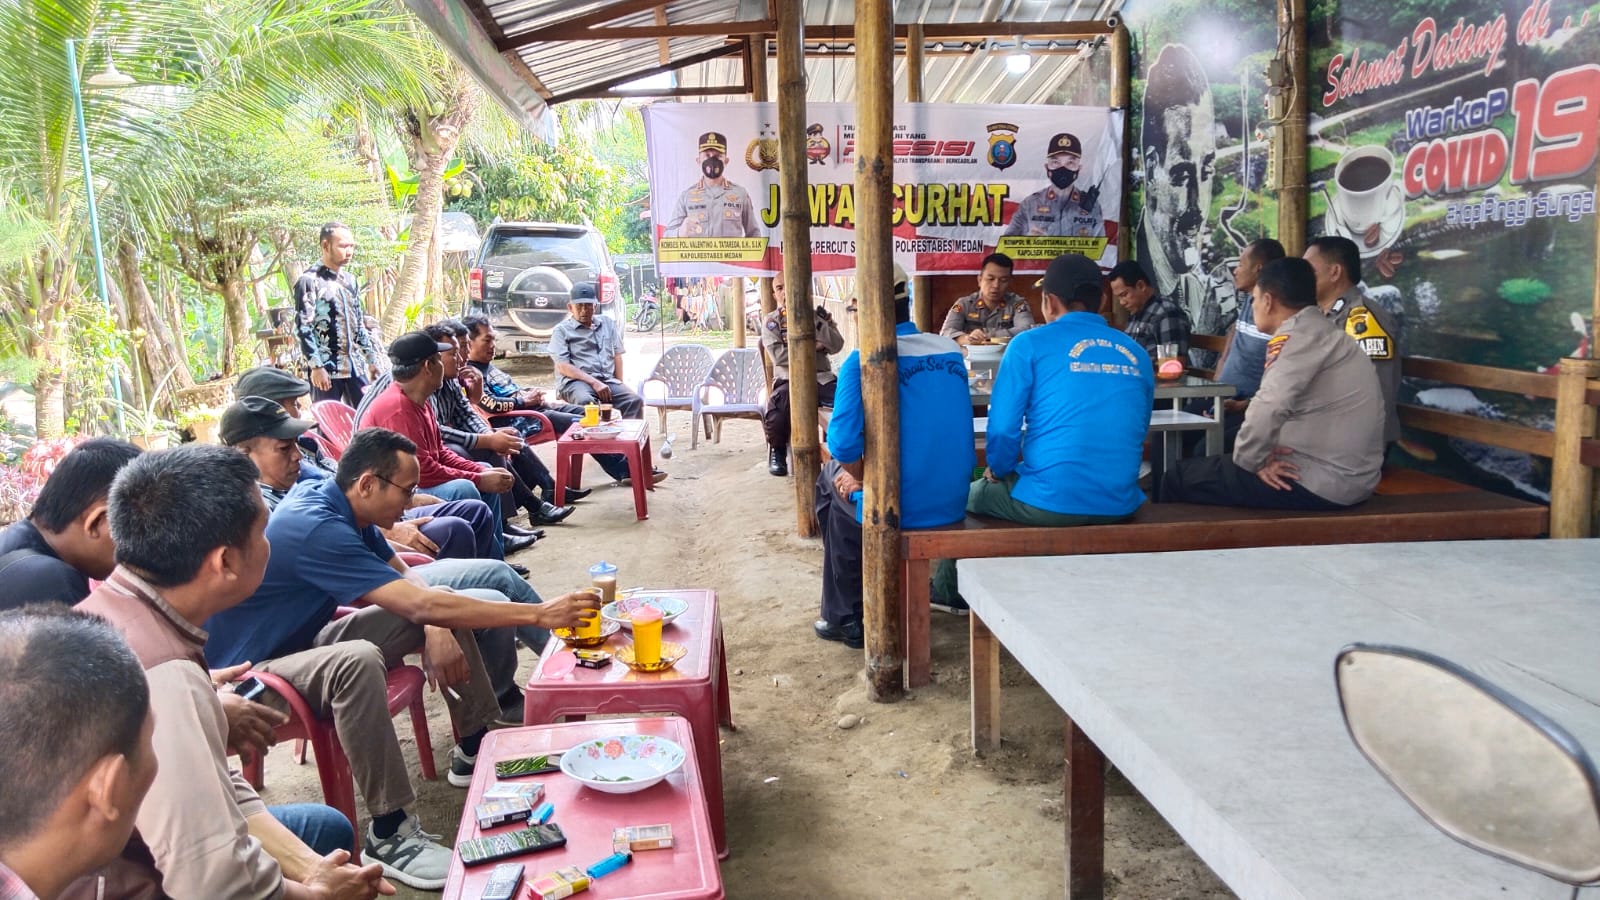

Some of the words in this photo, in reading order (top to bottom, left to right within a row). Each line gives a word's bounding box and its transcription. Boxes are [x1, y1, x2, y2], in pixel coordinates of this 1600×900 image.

[1323, 37, 1408, 106] Selamat
[1411, 16, 1507, 77] Datang
[1510, 63, 1600, 186] 19
[843, 140, 976, 156] ESISI
[1403, 129, 1509, 199] COVID
[892, 183, 1008, 227] CURHAT
[816, 241, 849, 254] PERCUT
[895, 240, 952, 254] POLRESTABES
[955, 240, 983, 254] MEDAN
